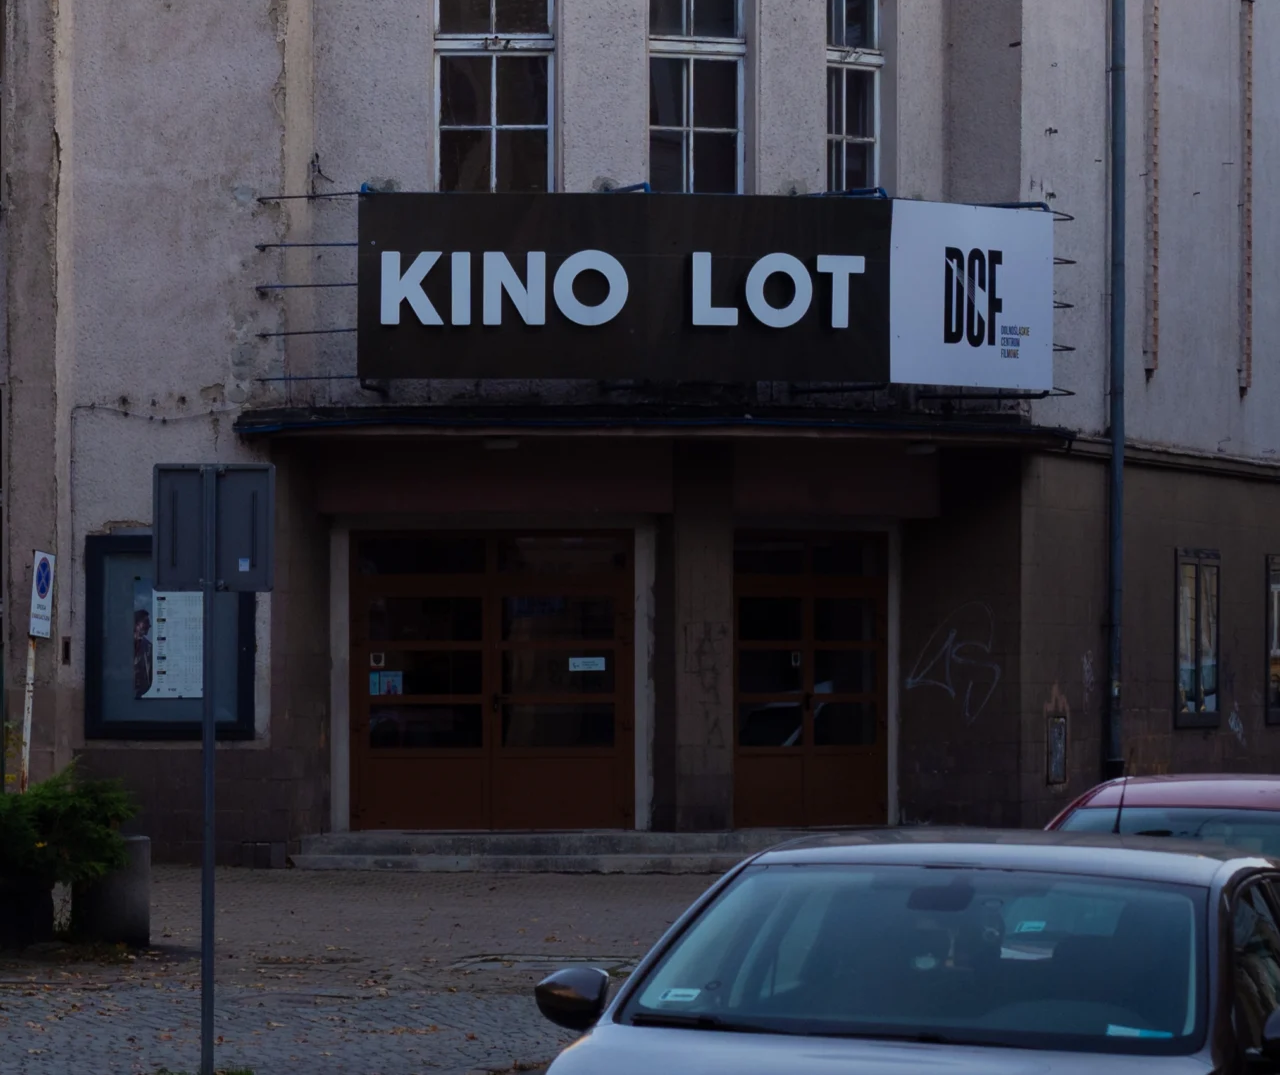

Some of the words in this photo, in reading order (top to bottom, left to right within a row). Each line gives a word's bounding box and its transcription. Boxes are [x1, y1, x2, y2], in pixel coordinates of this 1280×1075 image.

[380, 249, 629, 326] KINO
[692, 251, 865, 328] LOT
[944, 246, 1003, 348] DCF
